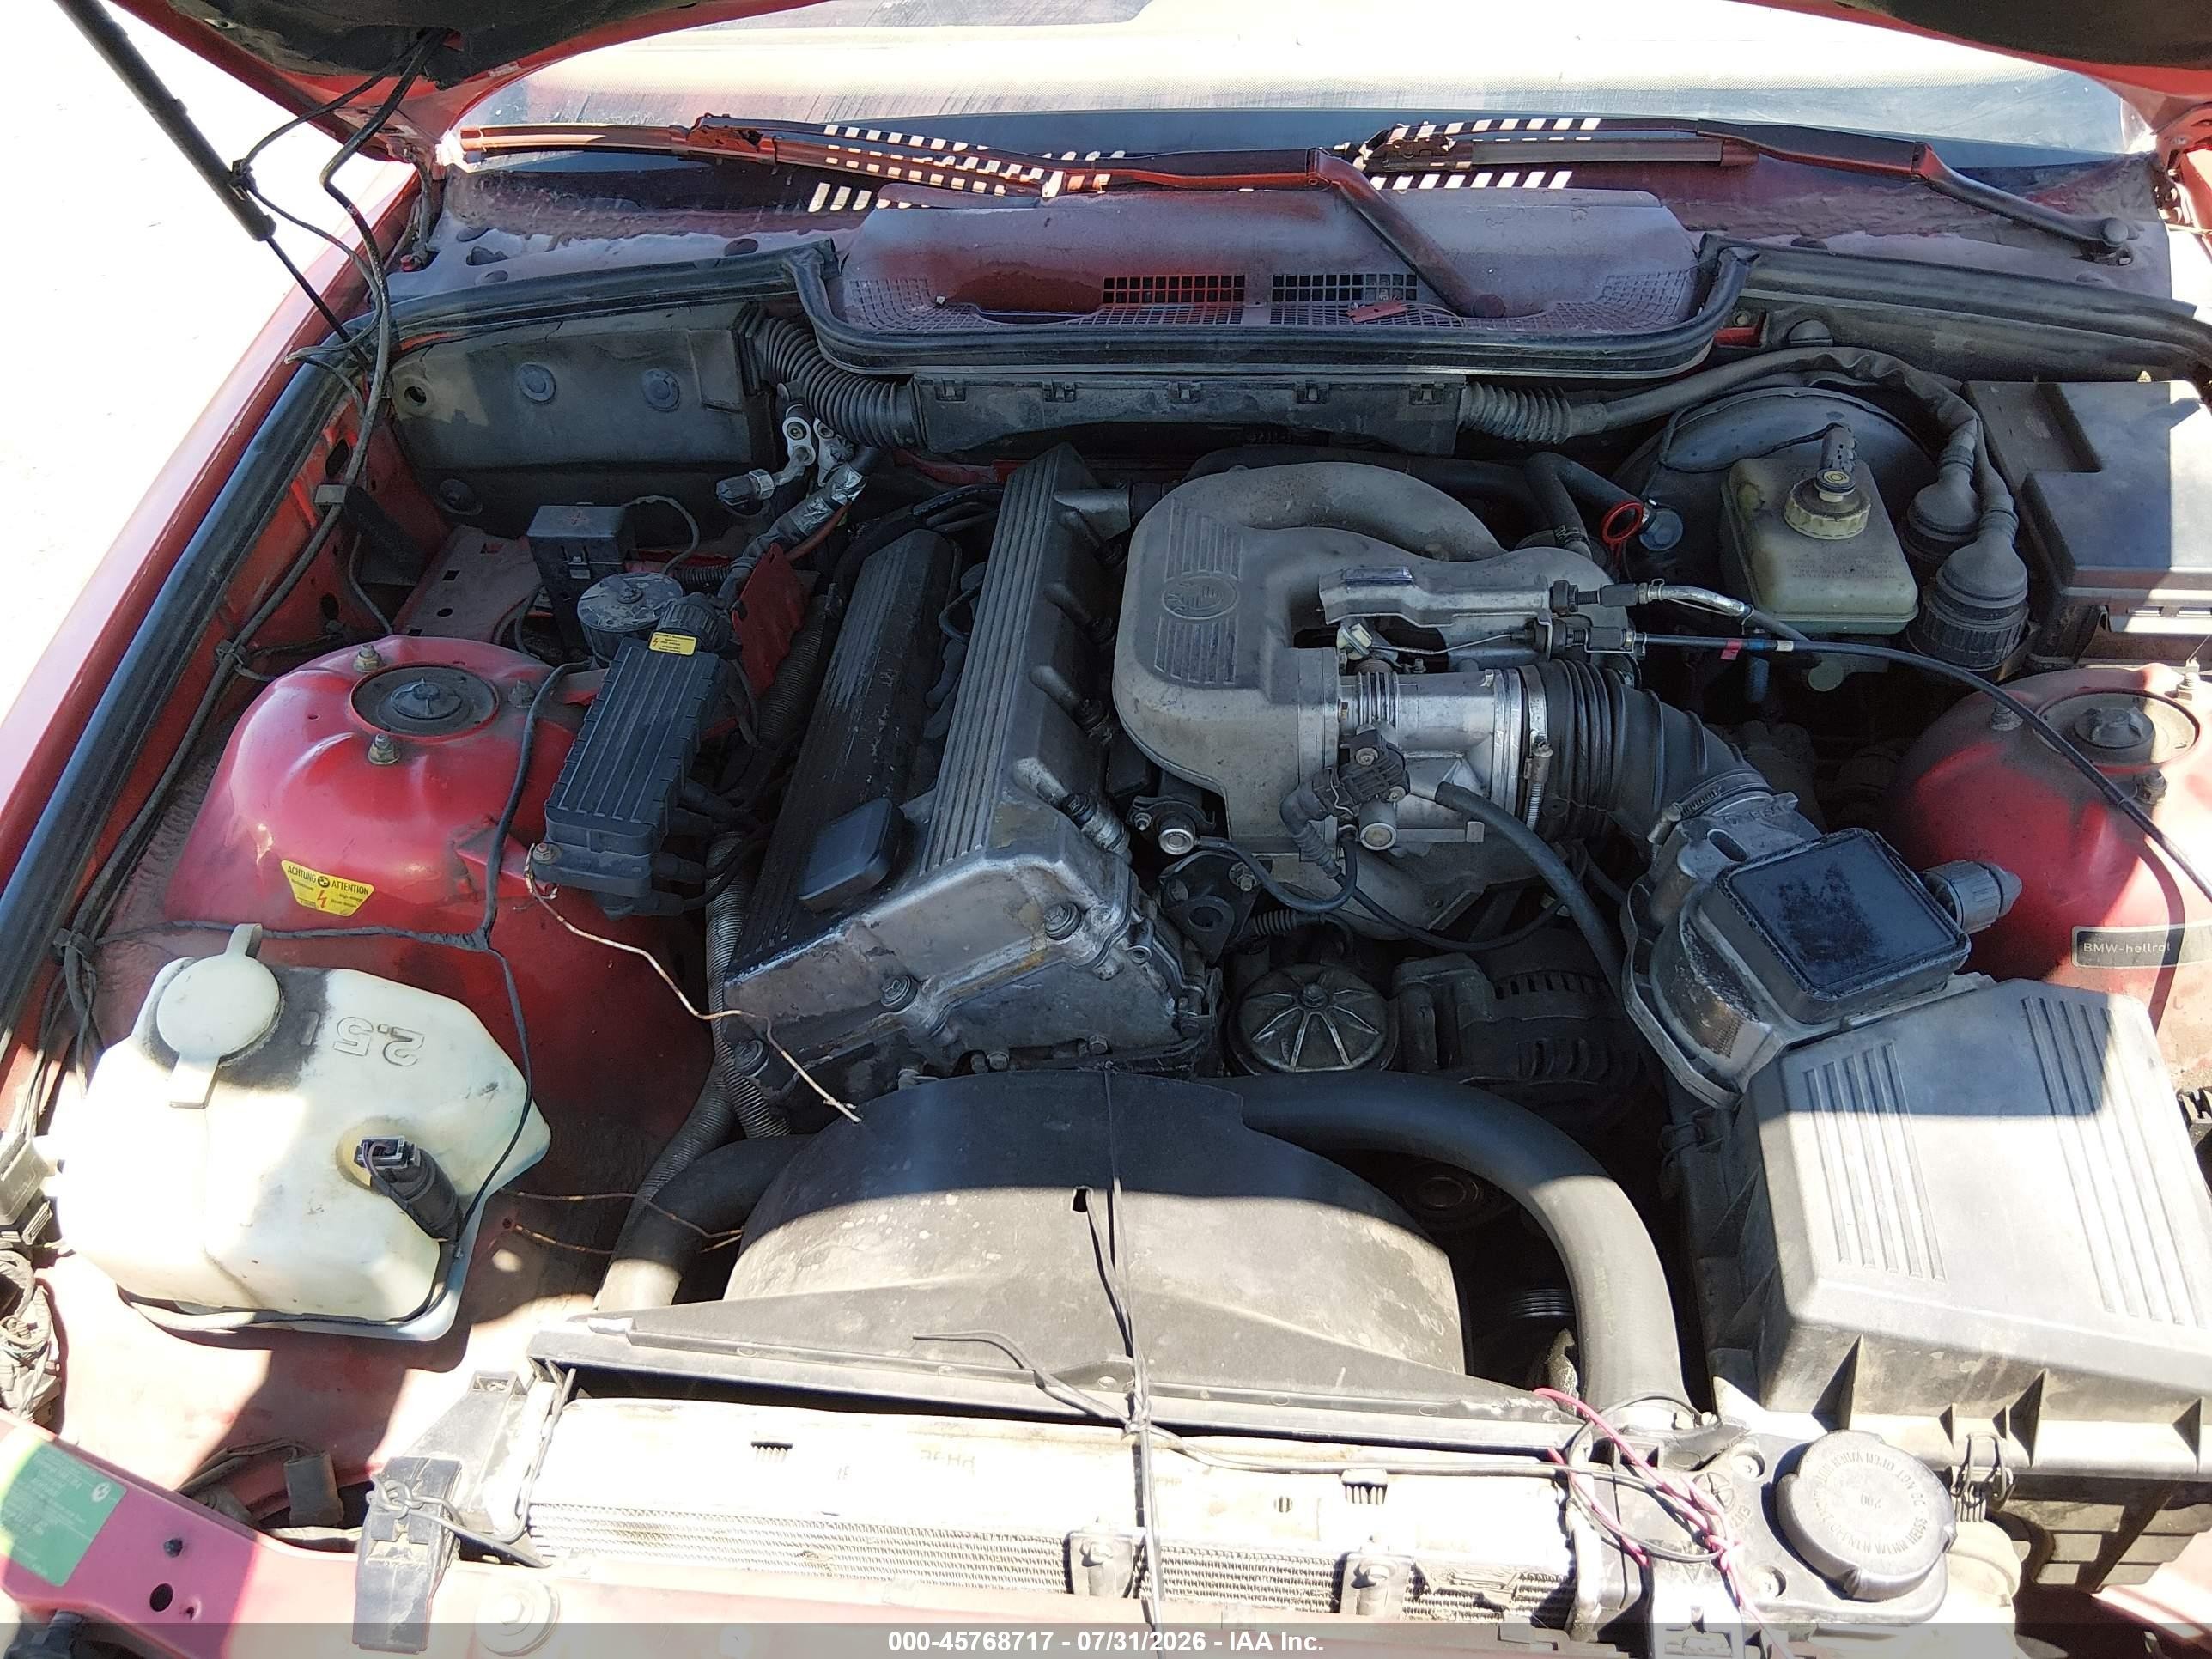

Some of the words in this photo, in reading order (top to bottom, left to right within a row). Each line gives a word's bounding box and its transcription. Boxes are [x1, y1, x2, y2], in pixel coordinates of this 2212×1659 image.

[288, 866, 316, 883] ACHTUNG
[331, 880, 369, 895] ATTENTION
[2083, 942, 2171, 954] BMW-hellrot
[332, 1016, 425, 1067] 2.5
